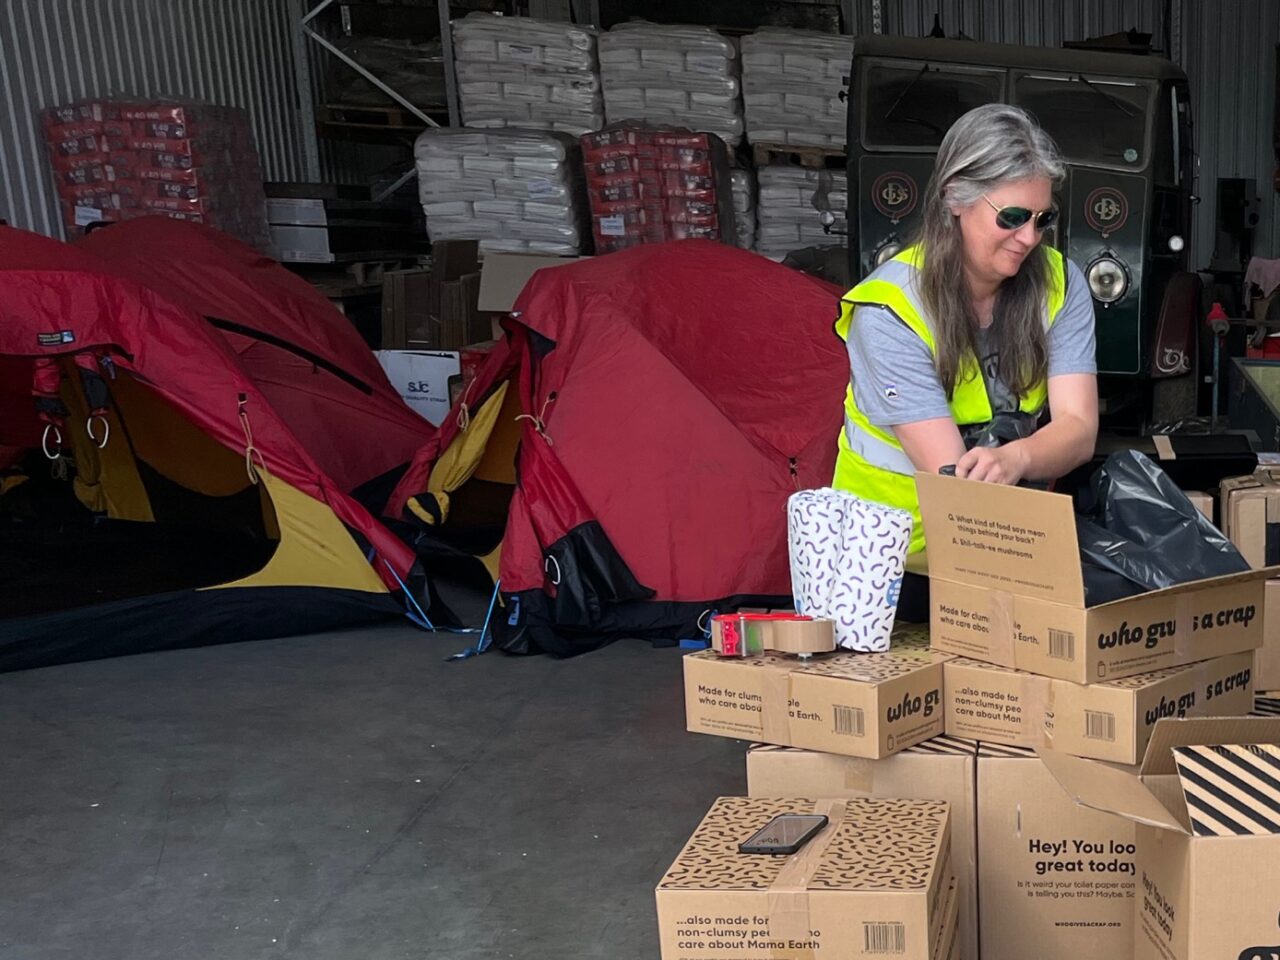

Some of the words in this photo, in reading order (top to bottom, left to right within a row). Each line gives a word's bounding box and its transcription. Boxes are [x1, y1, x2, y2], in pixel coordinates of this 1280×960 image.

[956, 515, 973, 525] What
[974, 518, 988, 527] kind
[996, 523, 1010, 532] food
[957, 524, 977, 535] things
[978, 528, 999, 538] behind
[1000, 532, 1014, 541] your
[1016, 536, 1035, 545] back?
[997, 548, 1033, 559] mushrooms
[972, 612, 990, 623] clum
[1098, 621, 1143, 650] who
[1201, 613, 1214, 630] a
[1216, 605, 1256, 628] crap
[698, 684, 723, 696] Made
[724, 688, 736, 699] for
[738, 690, 762, 702] clums
[981, 690, 1005, 700] made
[1007, 694, 1019, 702] for
[1146, 696, 1175, 725] who
[1215, 680, 1223, 696] a
[1224, 668, 1250, 692] crap
[699, 696, 717, 706] who
[718, 700, 738, 709] care
[740, 702, 762, 713] abou
[887, 692, 921, 723] who
[955, 697, 1003, 711] non-clumsy
[1005, 704, 1022, 713] peo
[797, 710, 823, 722] Earth.
[955, 707, 974, 716] care
[976, 710, 1001, 721] about
[1029, 839, 1067, 857] Hey!
[1072, 840, 1104, 854] You
[1109, 840, 1136, 854] loo
[1035, 859, 1084, 875] great
[676, 915, 712, 926] ...also
[715, 916, 750, 926] made
[753, 916, 769, 926] for
[677, 928, 747, 939] non-clumsy
[678, 940, 705, 949] care
[708, 940, 744, 949] about
[747, 940, 786, 949] Mama
[788, 940, 820, 949] Earth
